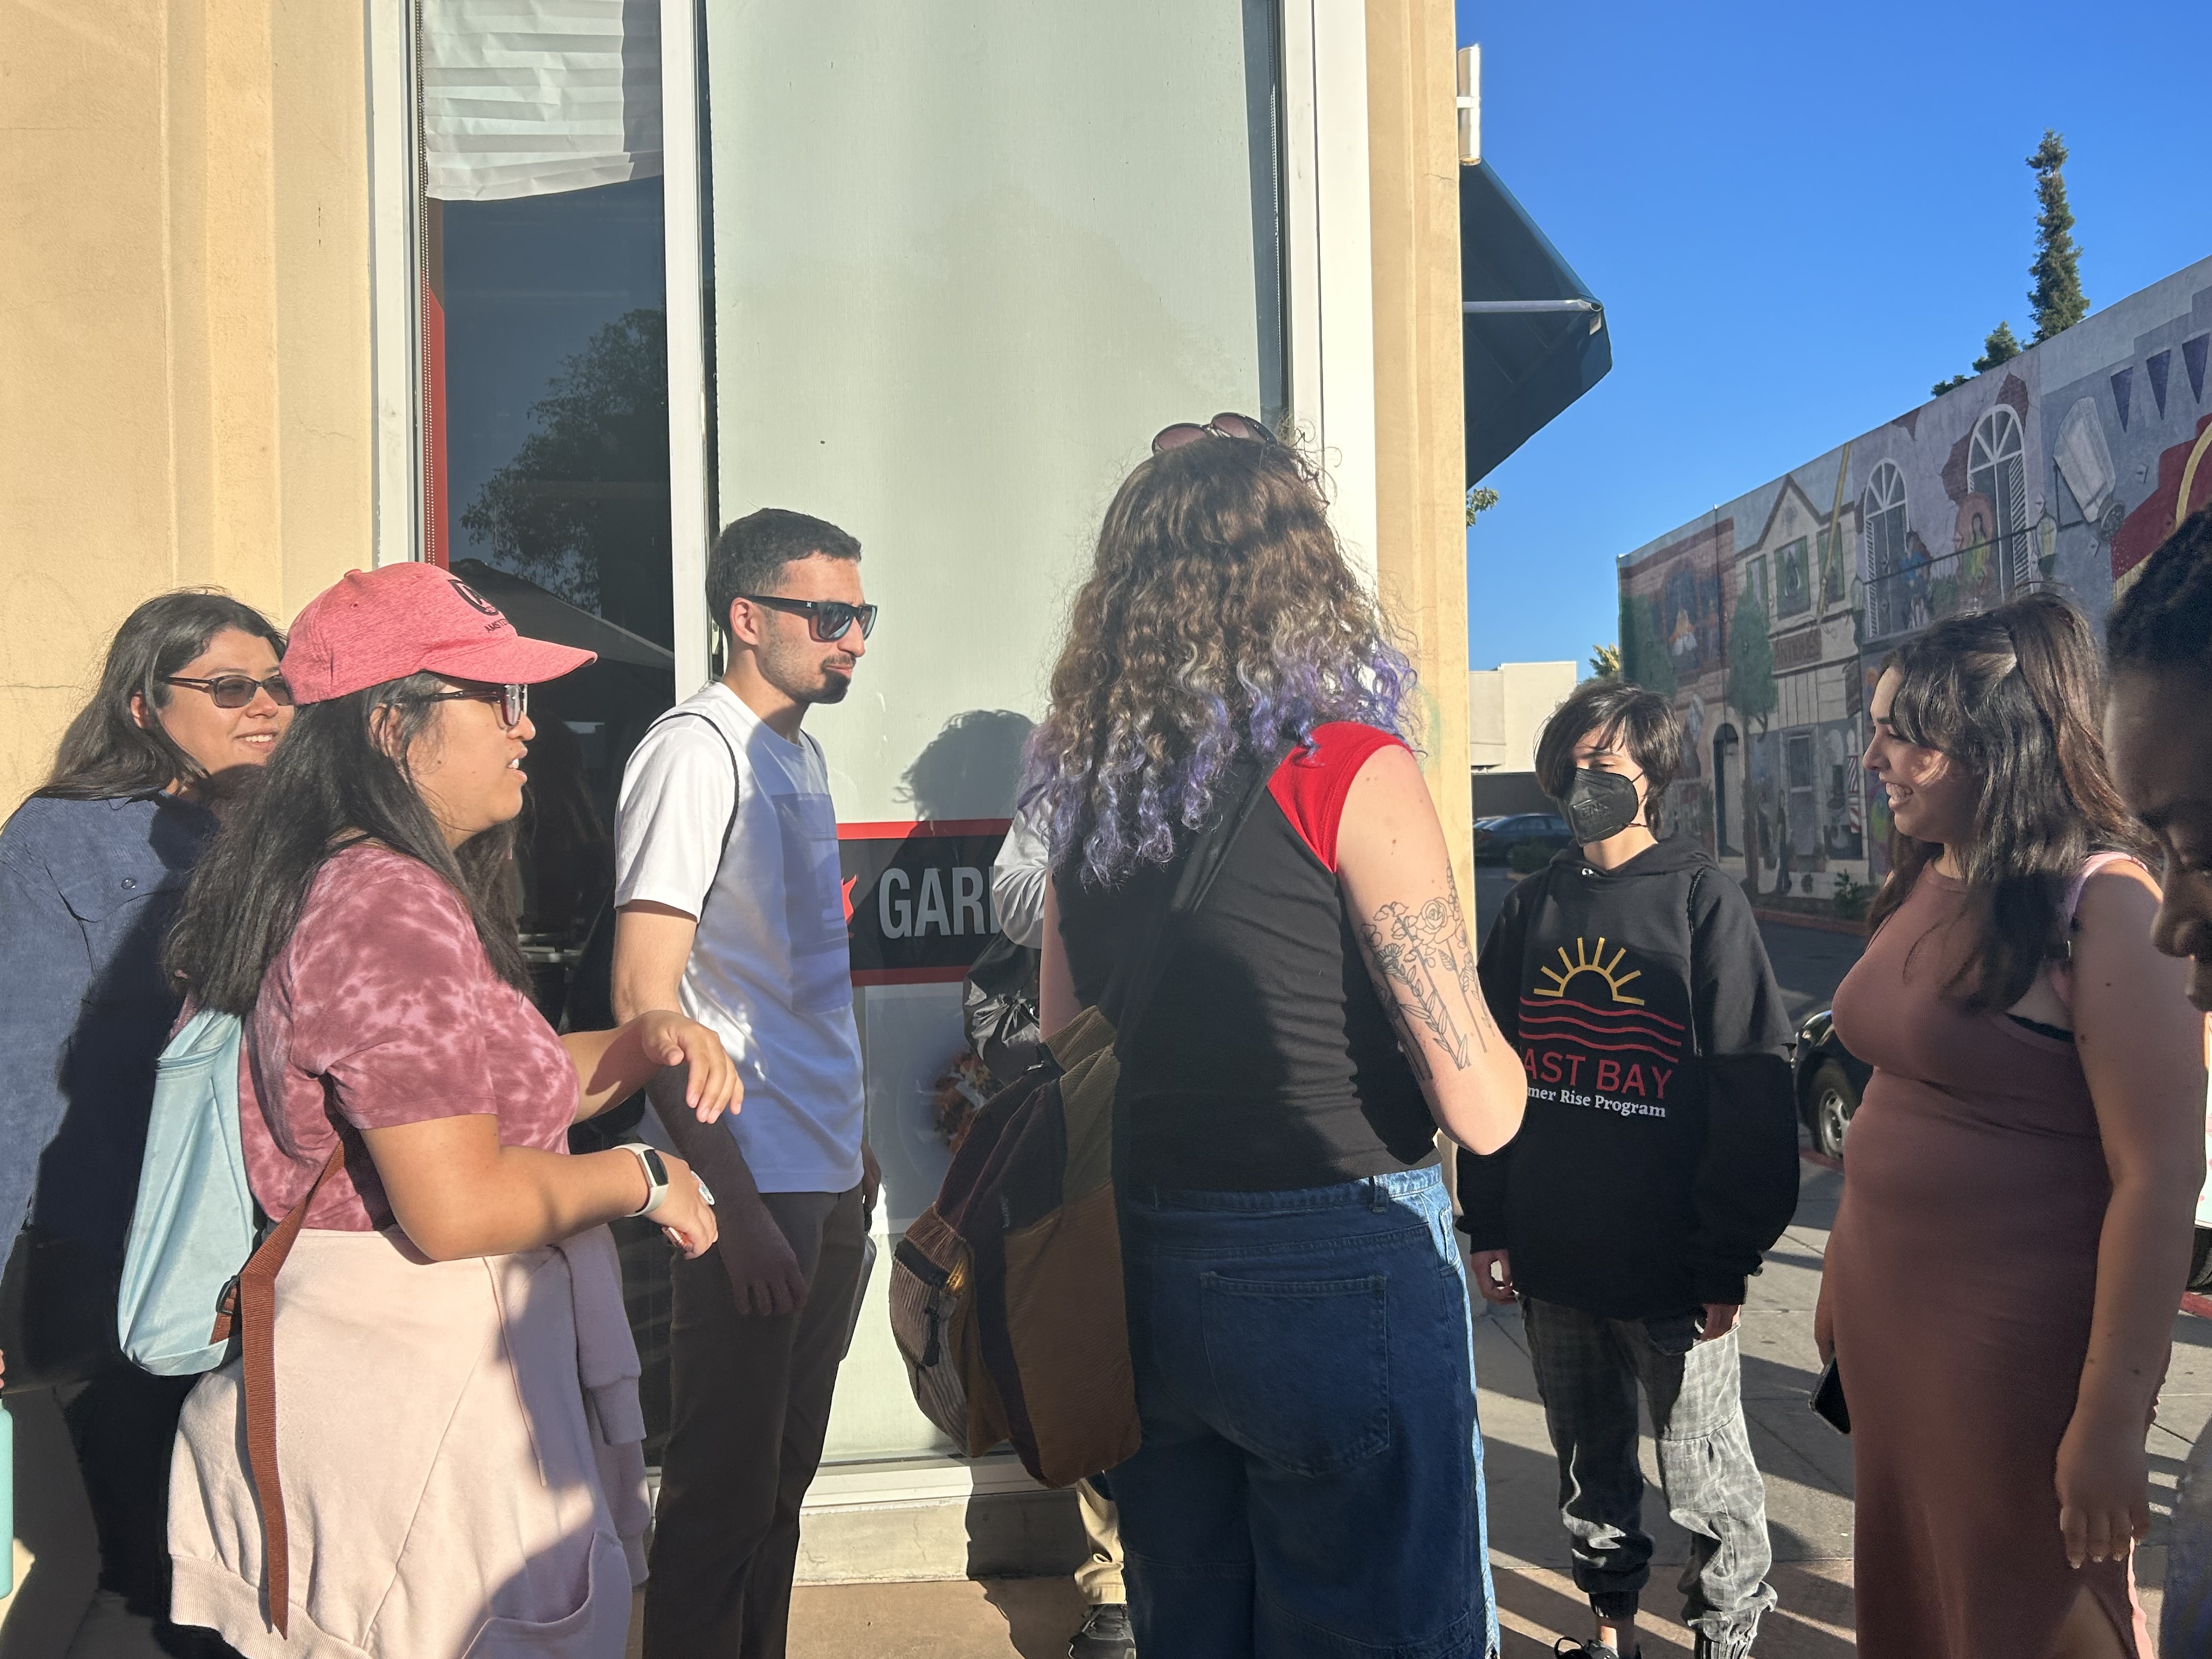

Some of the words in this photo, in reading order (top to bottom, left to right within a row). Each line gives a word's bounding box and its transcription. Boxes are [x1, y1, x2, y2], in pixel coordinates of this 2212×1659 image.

[484, 618, 509, 633] AMSTE
[1519, 1046, 1585, 1087] AST
[1596, 1059, 1673, 1100] BAY
[1527, 1086, 1556, 1102] mer
[1560, 1089, 1591, 1107] Rise
[1594, 1094, 1666, 1118] Program
